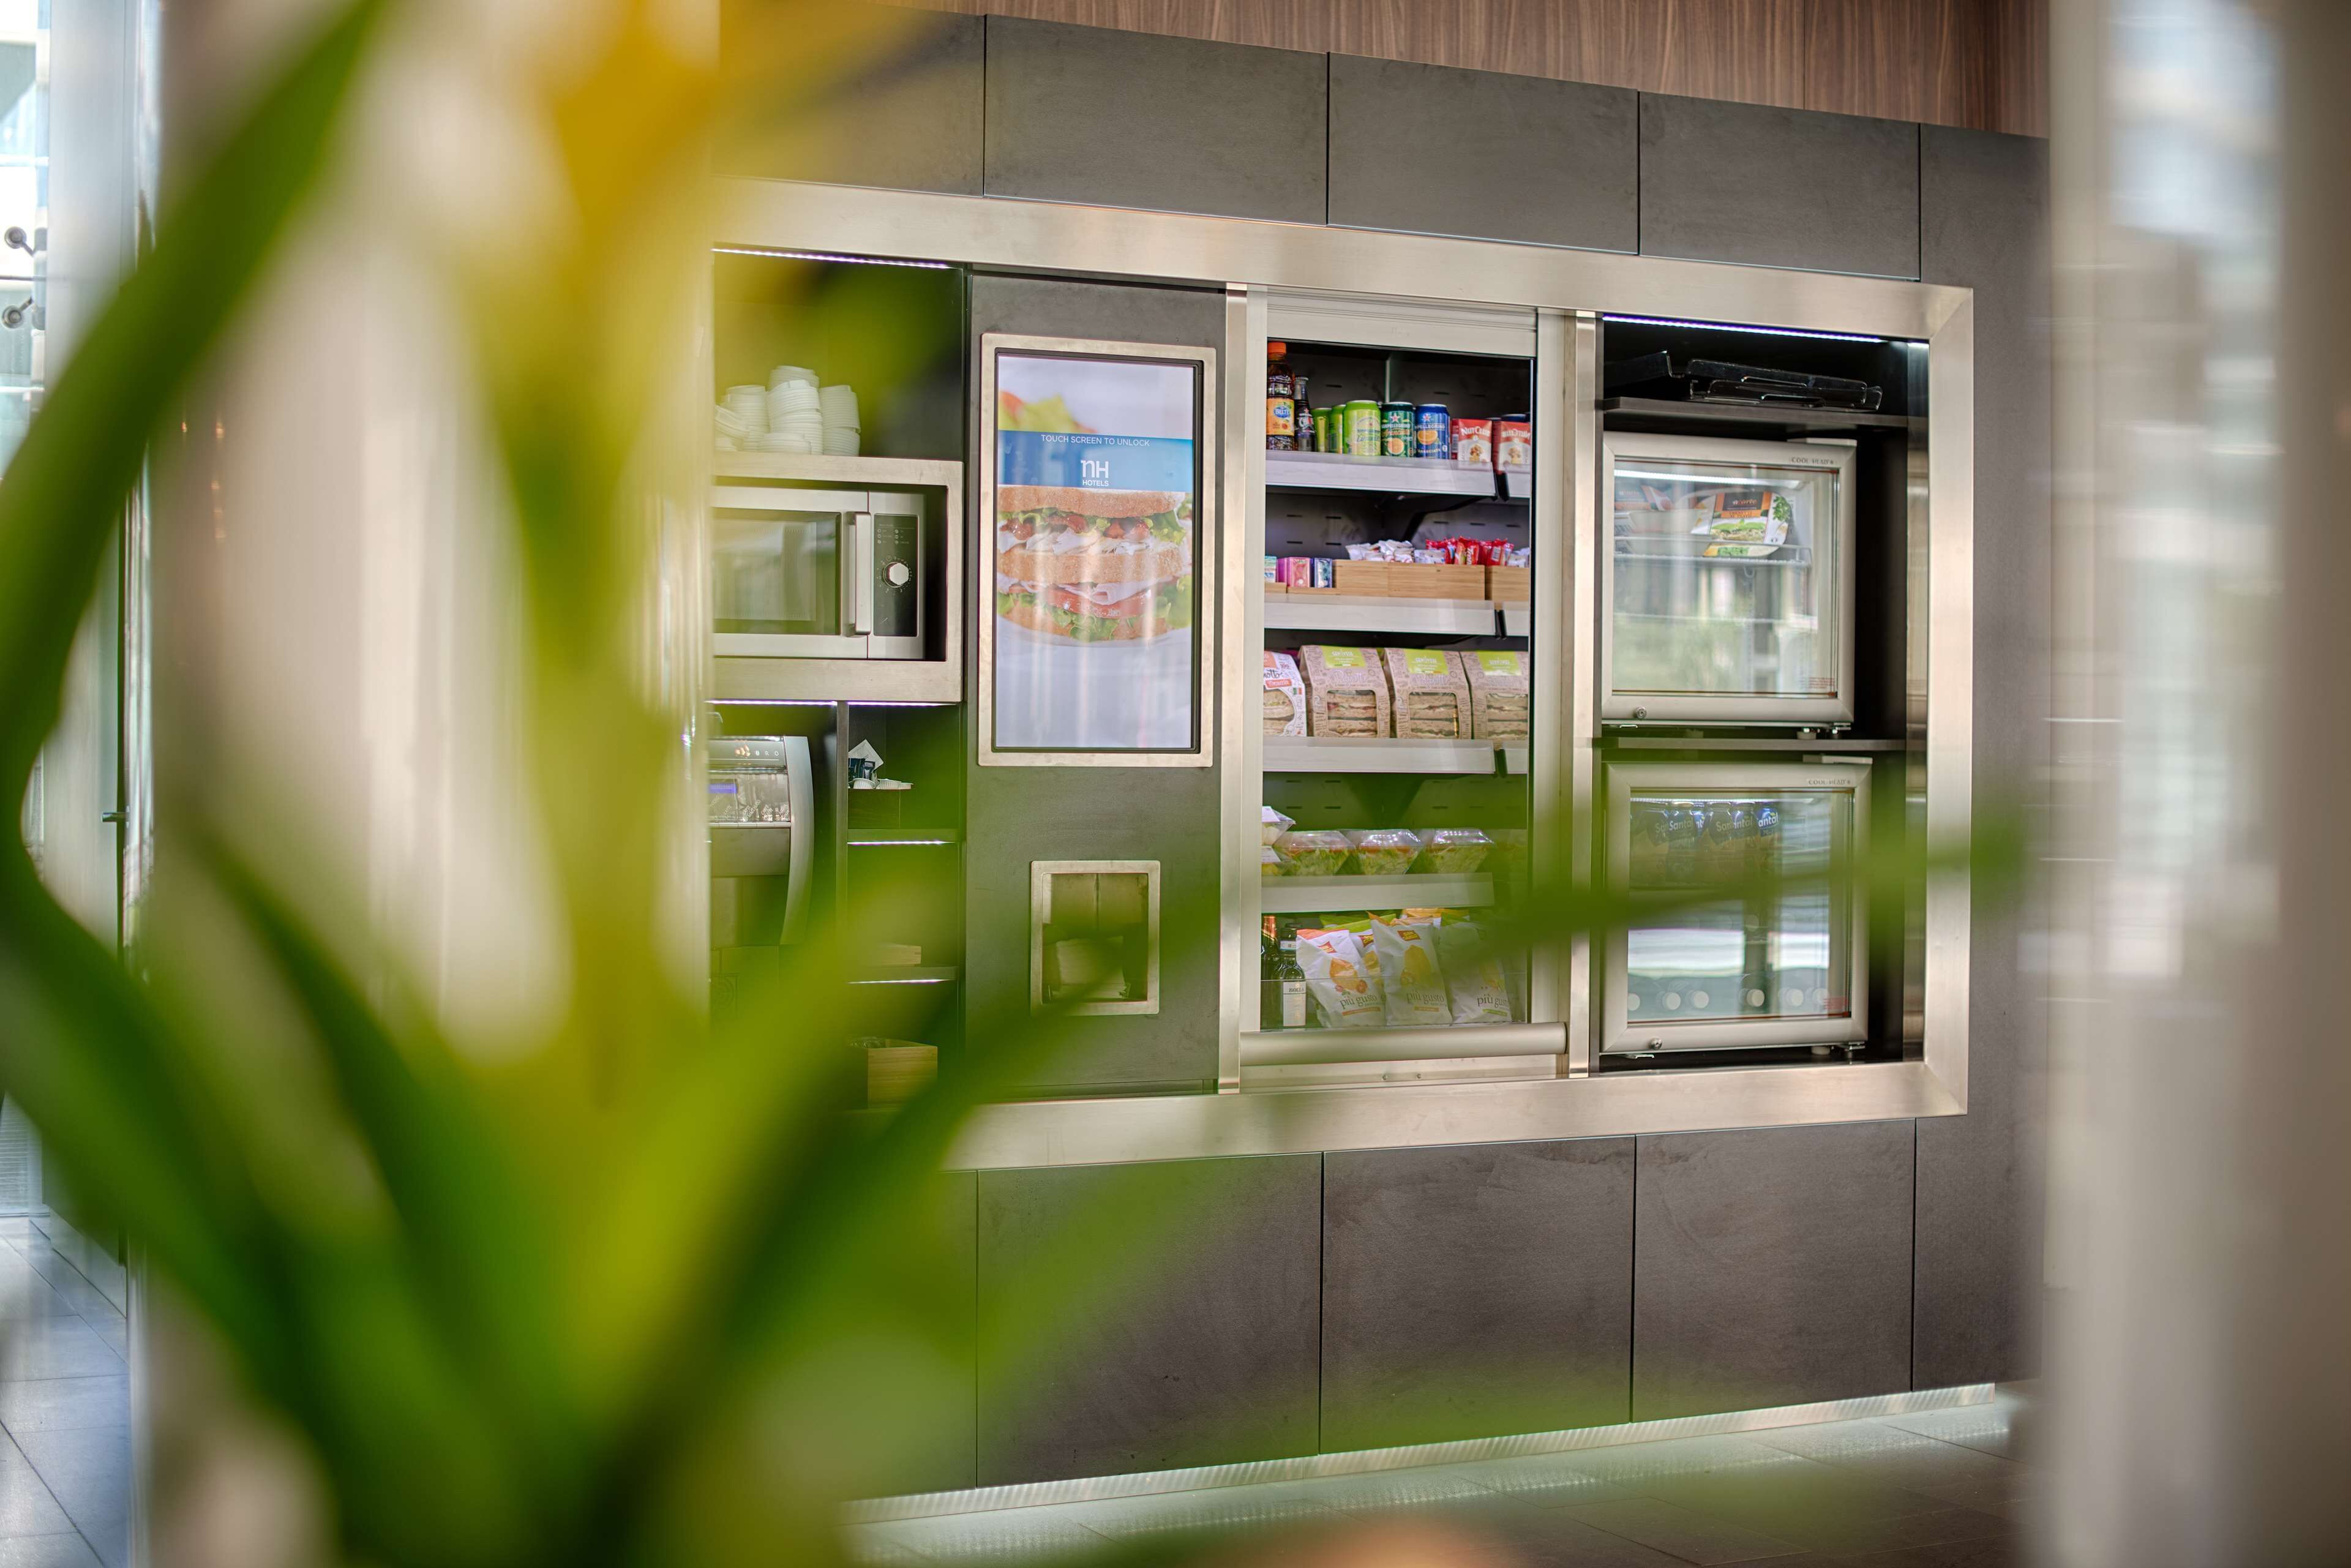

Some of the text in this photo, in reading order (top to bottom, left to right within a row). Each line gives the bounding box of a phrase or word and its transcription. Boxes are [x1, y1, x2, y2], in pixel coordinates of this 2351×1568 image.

[1071, 436, 1101, 445] SCREEN
[1670, 819, 1694, 831] Santal
[1757, 812, 1779, 828] antal
[1477, 994, 1493, 1007] più
